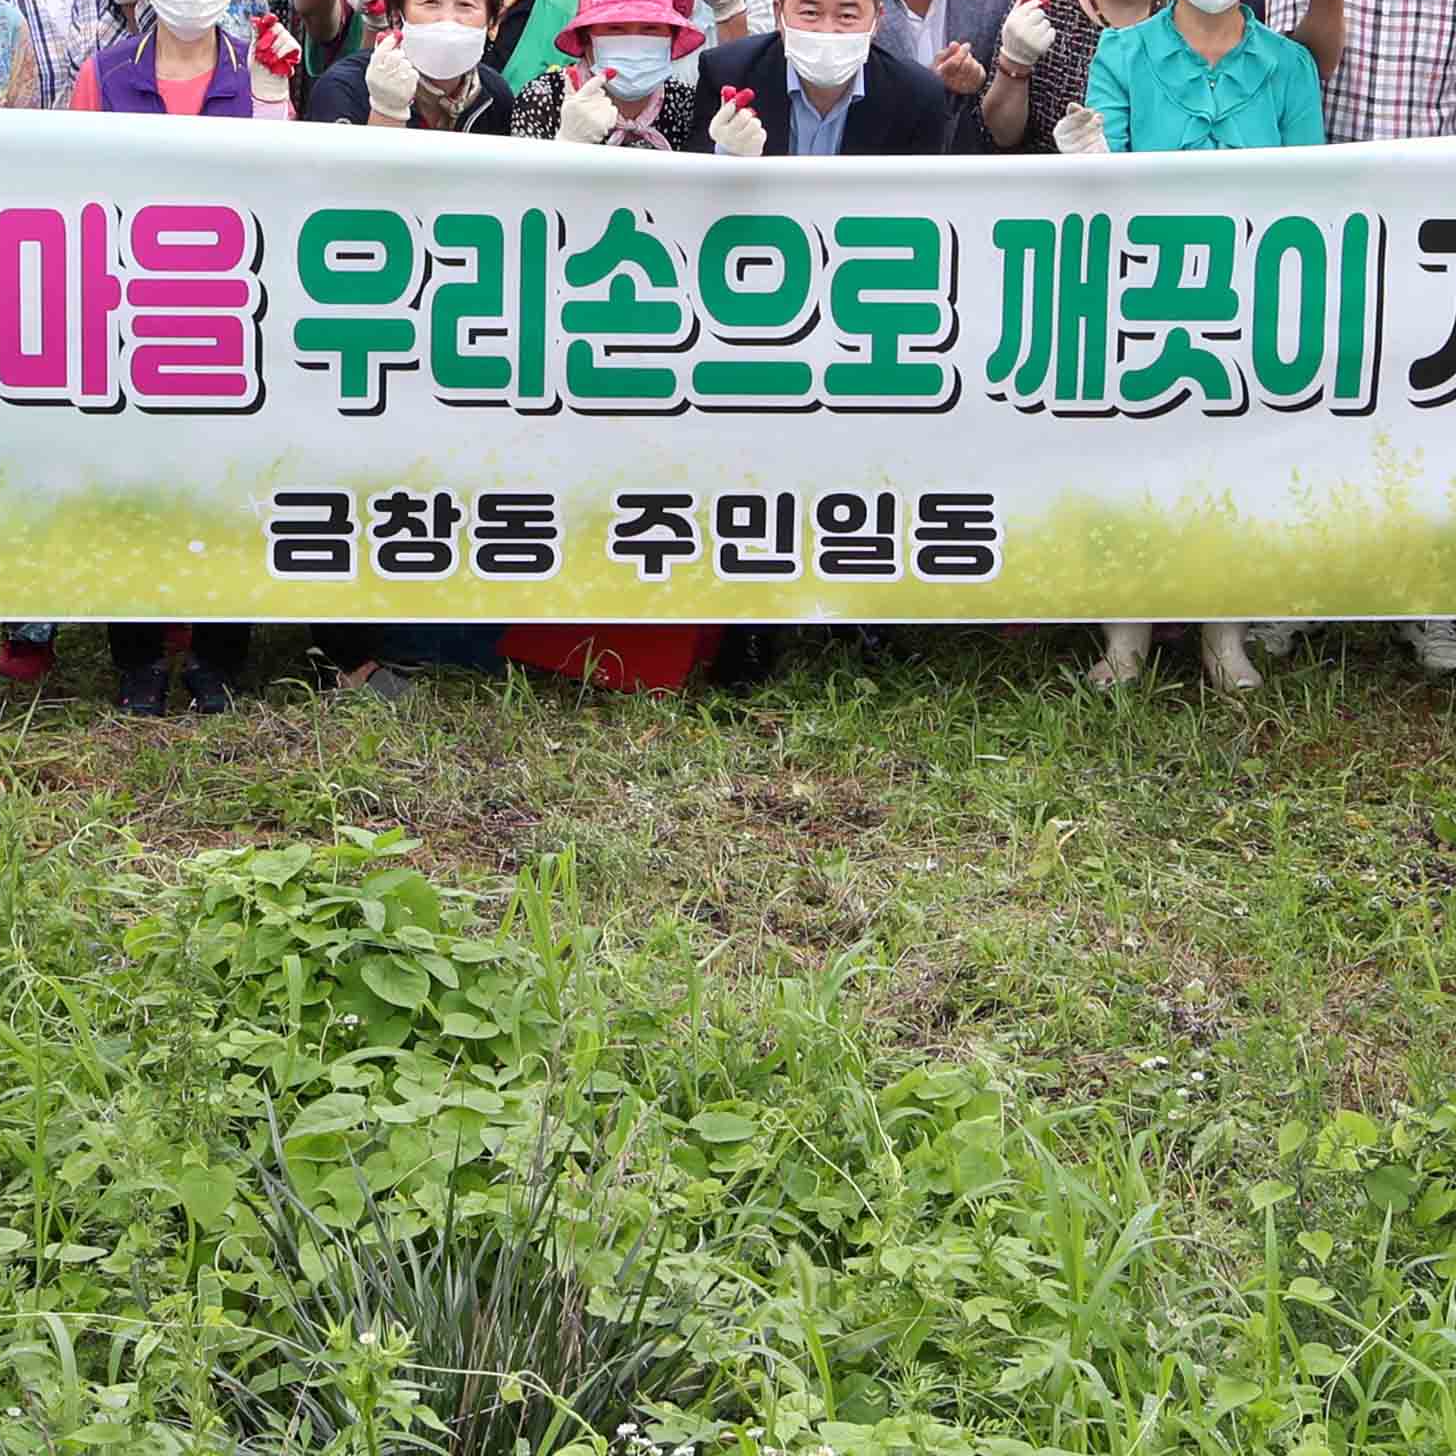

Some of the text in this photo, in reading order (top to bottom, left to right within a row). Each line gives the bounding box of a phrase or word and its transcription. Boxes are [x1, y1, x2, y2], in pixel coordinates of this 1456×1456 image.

[293, 206, 954, 408] 우리손으로
[985, 212, 1380, 410] 깨끗이
[269, 491, 998, 576] 금창동 주민일동
